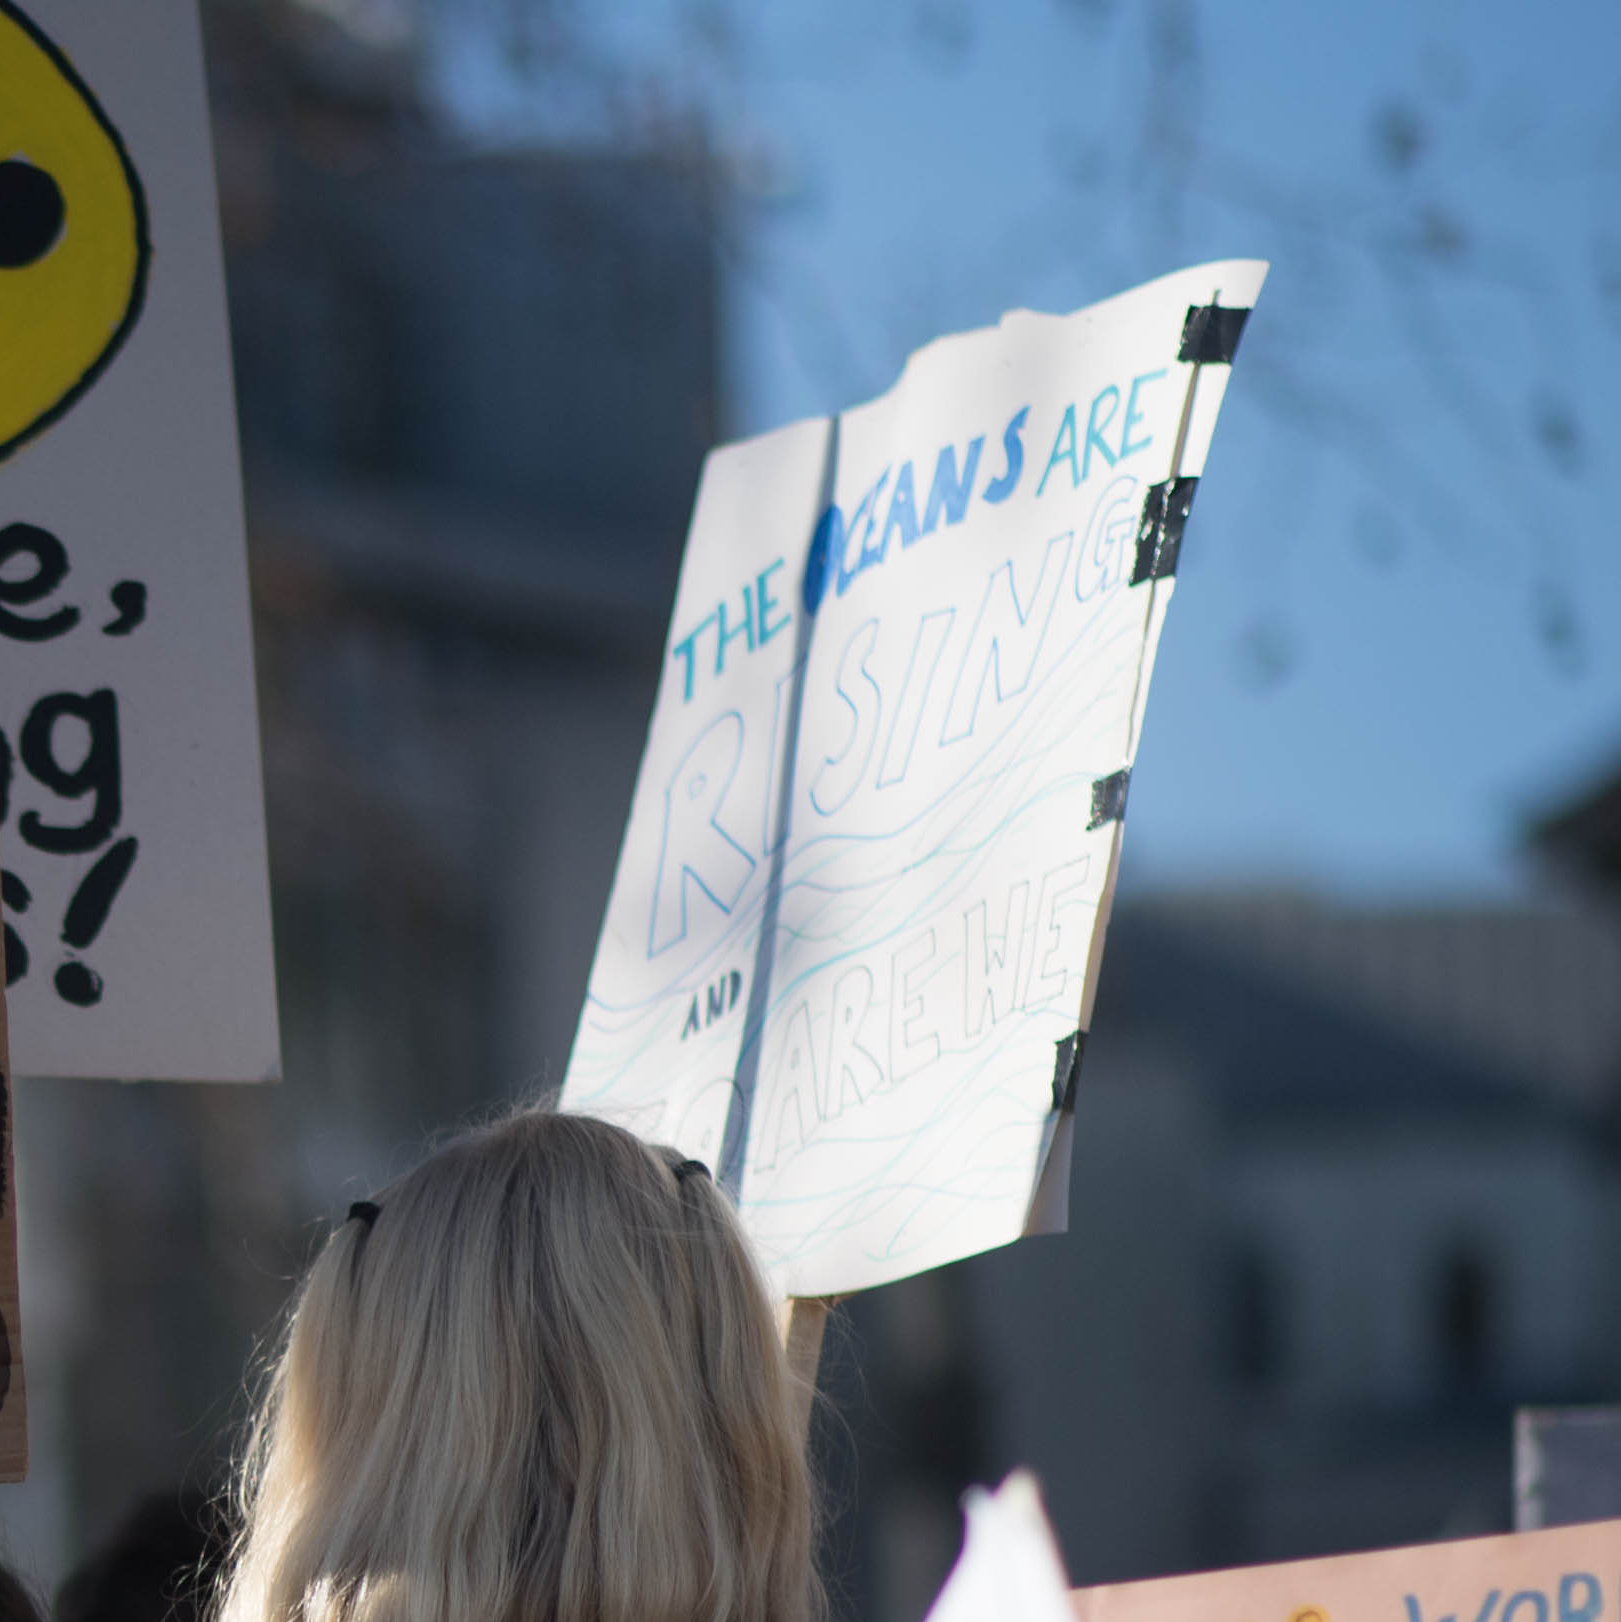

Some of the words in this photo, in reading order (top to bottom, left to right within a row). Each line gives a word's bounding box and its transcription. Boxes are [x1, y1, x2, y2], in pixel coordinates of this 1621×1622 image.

[672, 556, 791, 702] THE
[801, 404, 1030, 617] OCEANS
[1035, 367, 1168, 499] ARE
[646, 474, 1139, 961] RISING
[680, 969, 742, 1042] AND
[963, 854, 1091, 1040] WE
